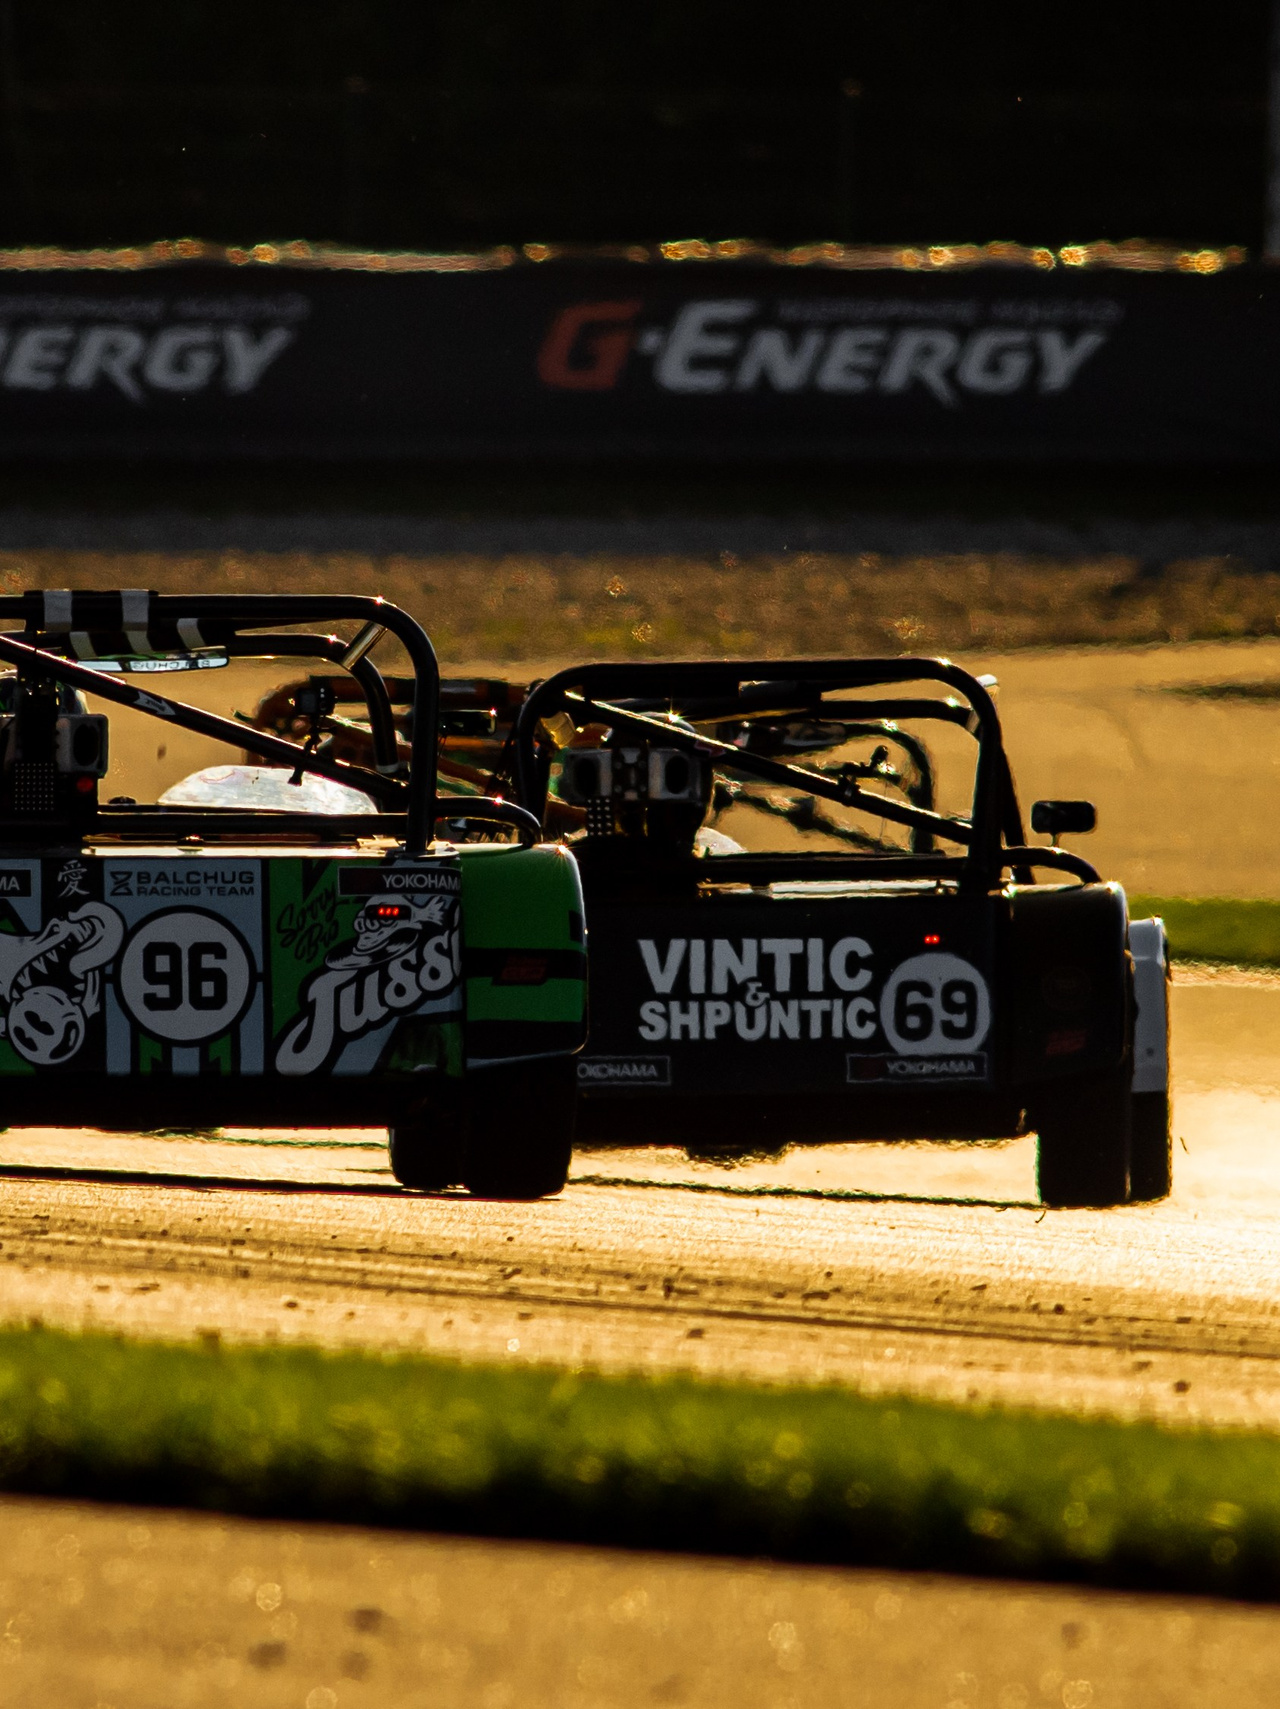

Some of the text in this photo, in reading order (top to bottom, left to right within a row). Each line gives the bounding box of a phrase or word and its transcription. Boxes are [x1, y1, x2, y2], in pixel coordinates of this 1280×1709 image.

[56, 858, 90, 897] 愛
[136, 871, 255, 885] BALCHUG
[136, 886, 255, 897] RACING TEAM
[382, 874, 461, 891] YOKOHAM
[143, 942, 227, 1010] 96
[637, 936, 874, 995] VINTIC
[746, 978, 770, 1007] &
[638, 999, 877, 1041] SHPUNTIC
[893, 980, 977, 1042] 69
[886, 1060, 976, 1074] YOKOHAMA
